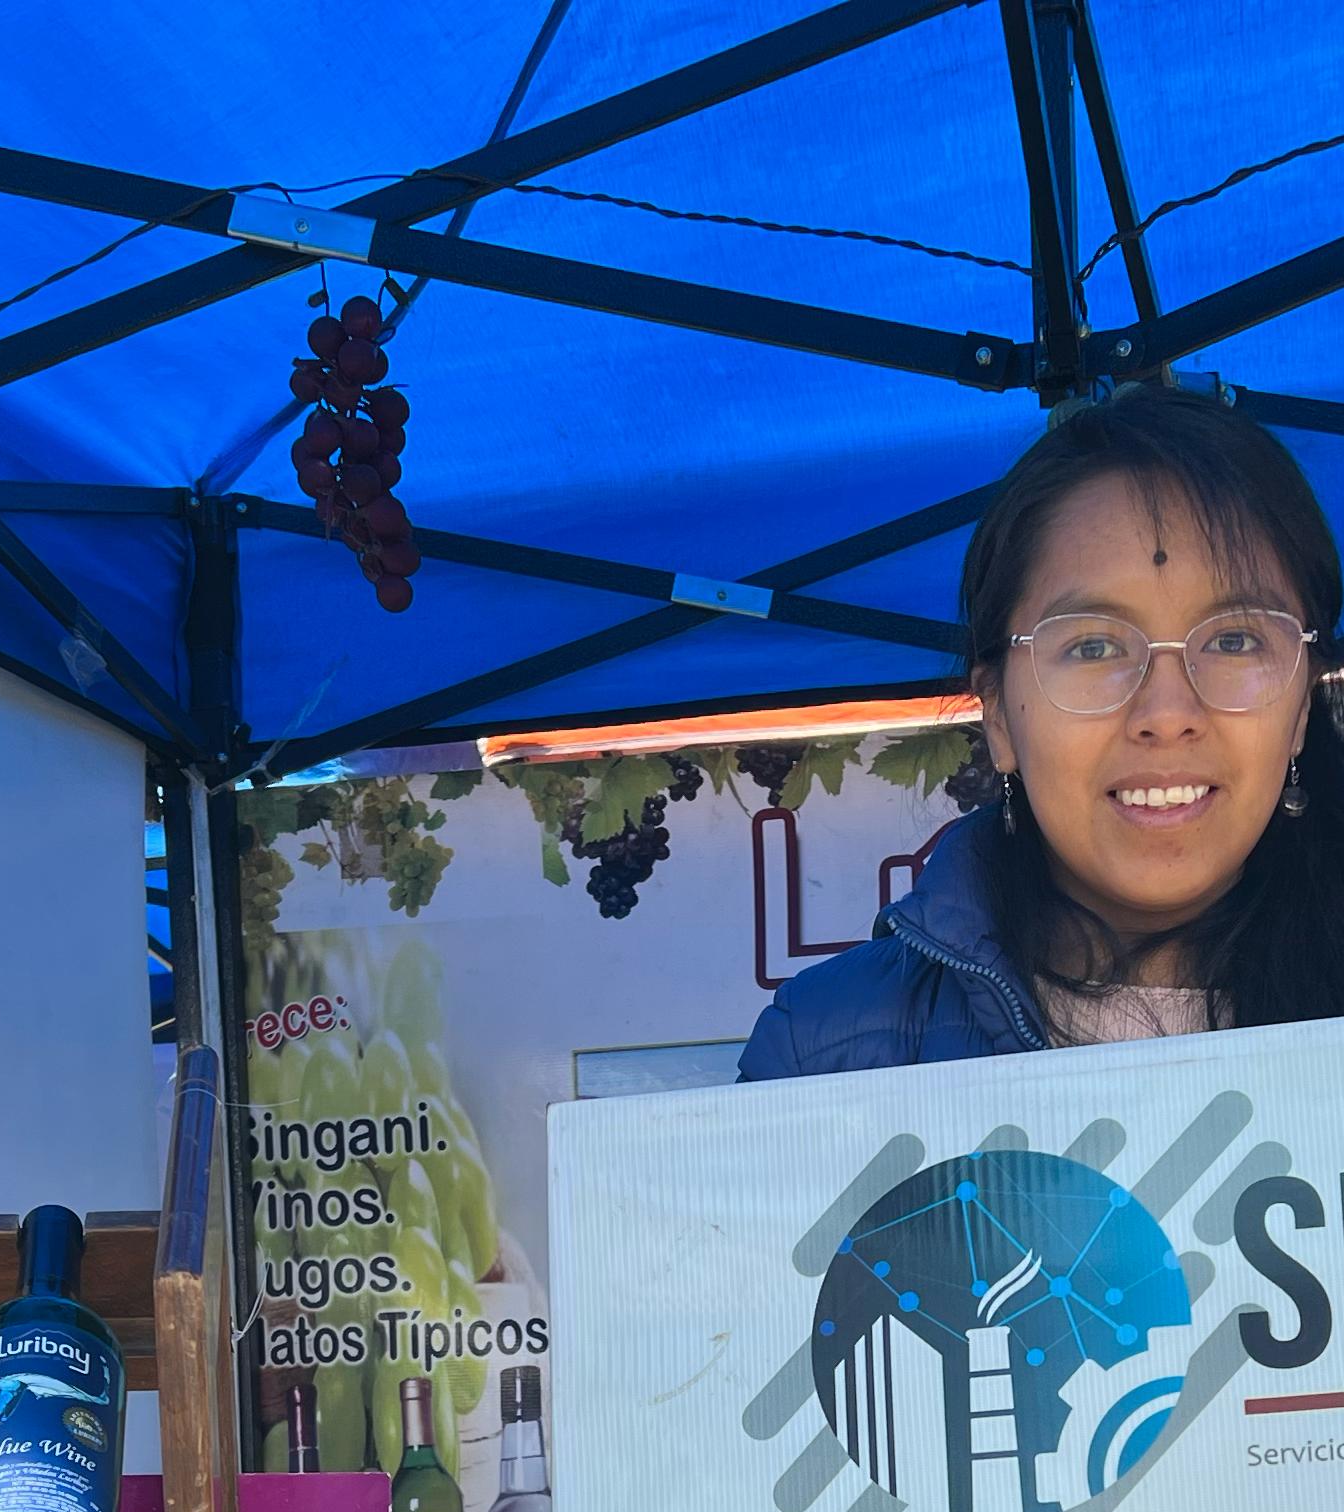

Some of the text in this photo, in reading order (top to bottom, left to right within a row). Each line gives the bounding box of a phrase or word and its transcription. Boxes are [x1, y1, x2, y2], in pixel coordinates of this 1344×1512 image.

[266, 1257, 412, 1307] ugos.
[258, 1309, 549, 1371] latos Típicos
[39, 1439, 96, 1472] Wine
